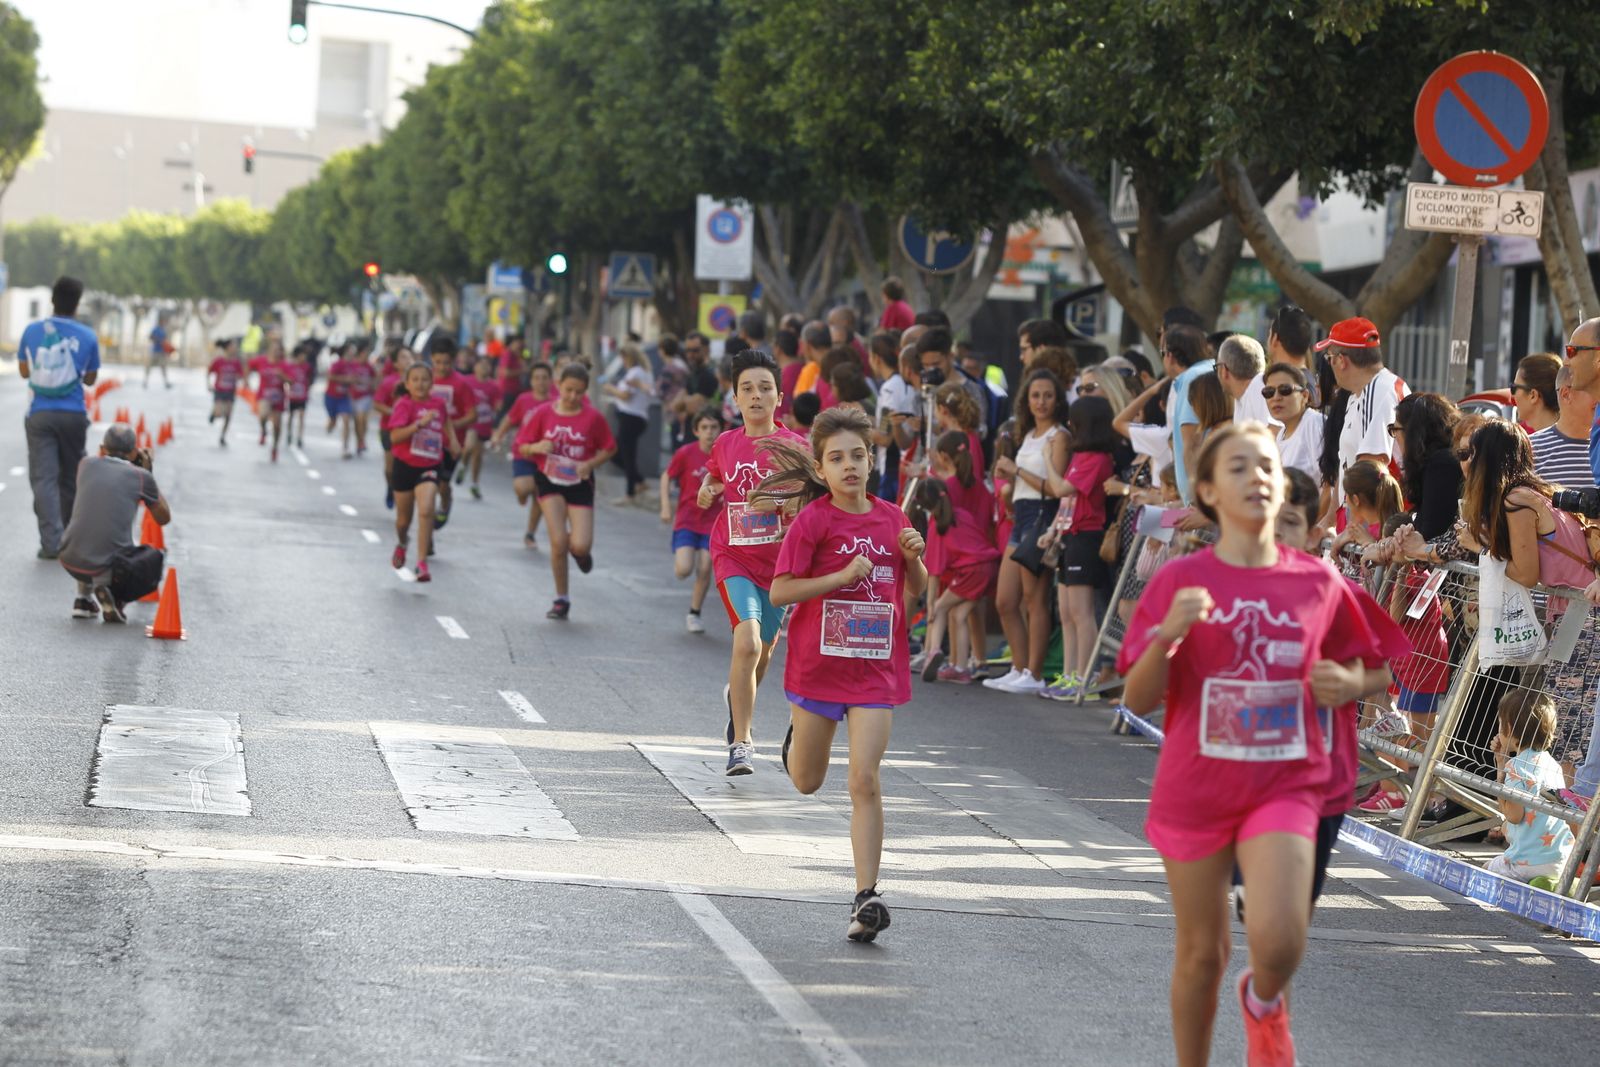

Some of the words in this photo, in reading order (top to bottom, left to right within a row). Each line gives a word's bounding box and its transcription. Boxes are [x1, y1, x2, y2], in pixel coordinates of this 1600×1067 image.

[1414, 189, 1458, 201] EXCEPTO
[1461, 193, 1495, 204] MOTOS
[1416, 202, 1490, 216] CICLOMOTORE
[1421, 216, 1427, 225] Y
[1429, 216, 1484, 228] BICICLETAS
